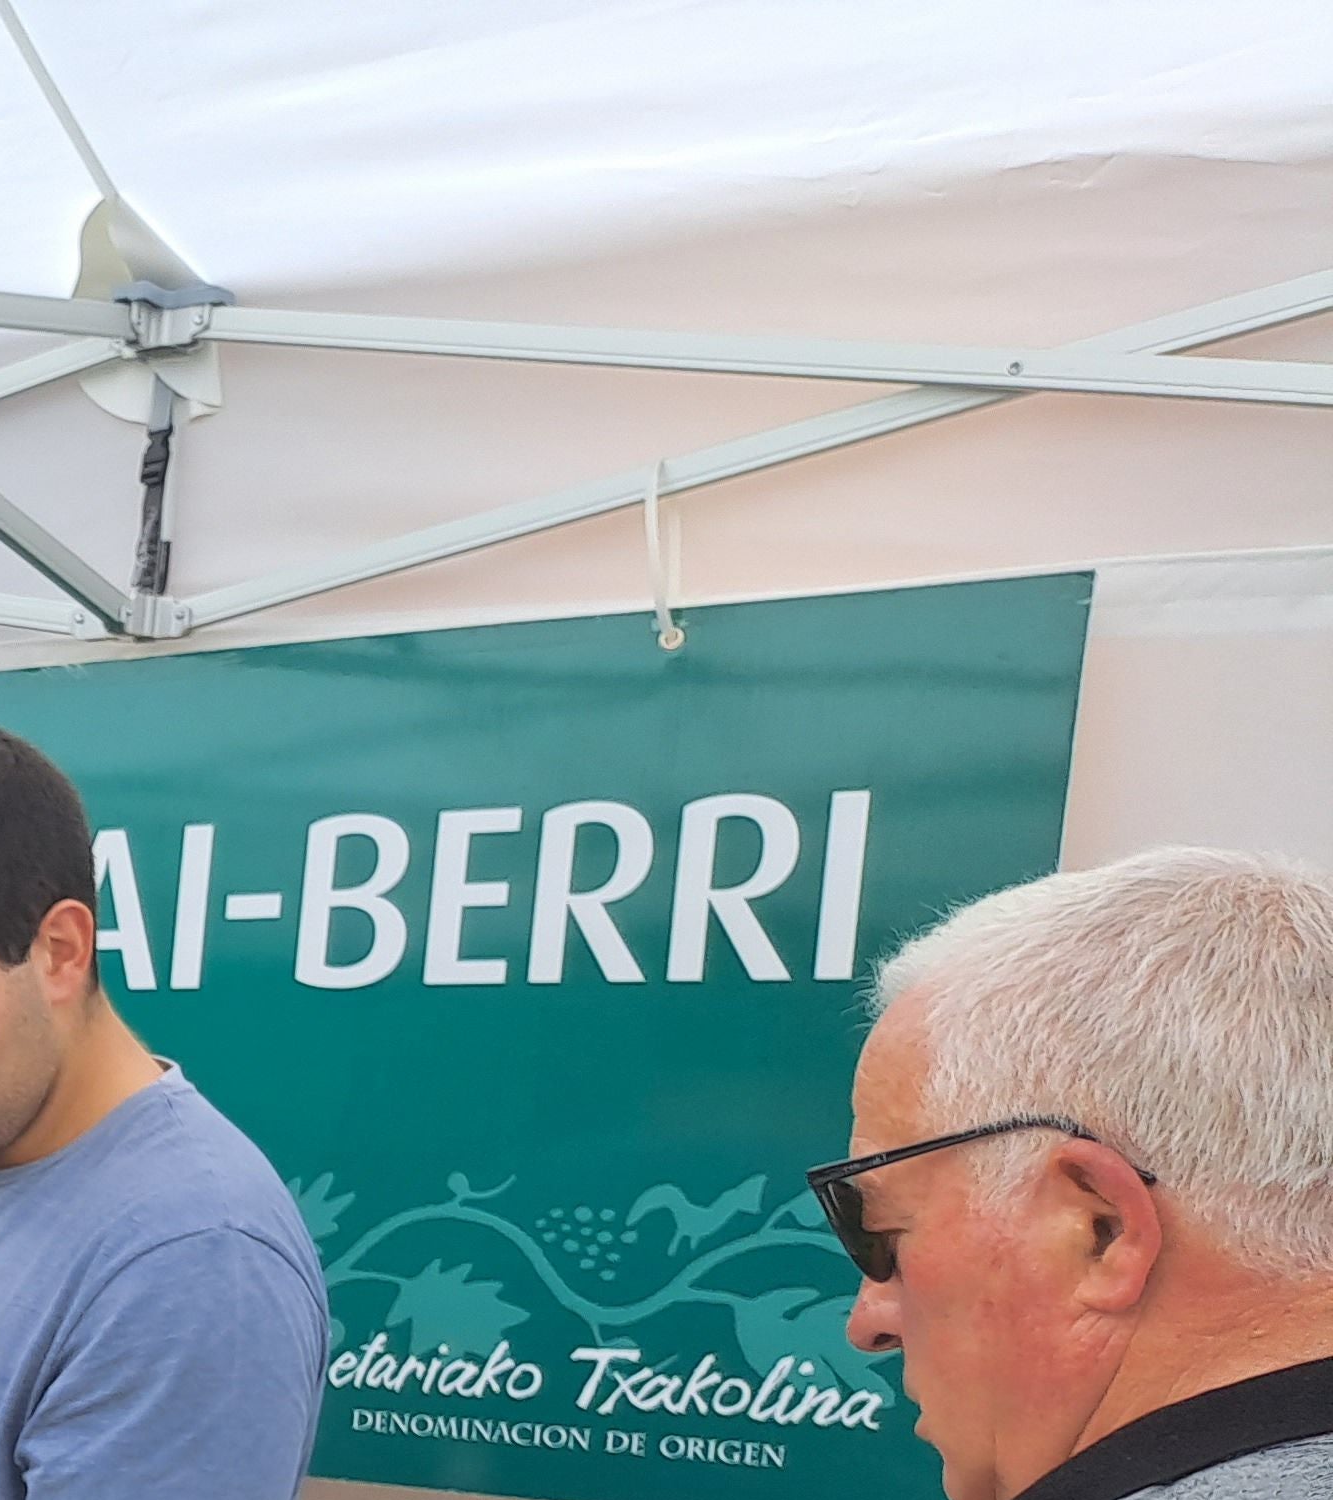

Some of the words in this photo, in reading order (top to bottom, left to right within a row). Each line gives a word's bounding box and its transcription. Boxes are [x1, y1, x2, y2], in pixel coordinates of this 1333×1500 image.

[91, 789, 872, 991] AI-BERRI
[328, 1331, 543, 1401] etariako
[569, 1346, 885, 1432] Txakolina
[351, 1407, 592, 1451] DENOMINACION
[604, 1429, 647, 1458] DE
[658, 1434, 787, 1470] ORIGEN
